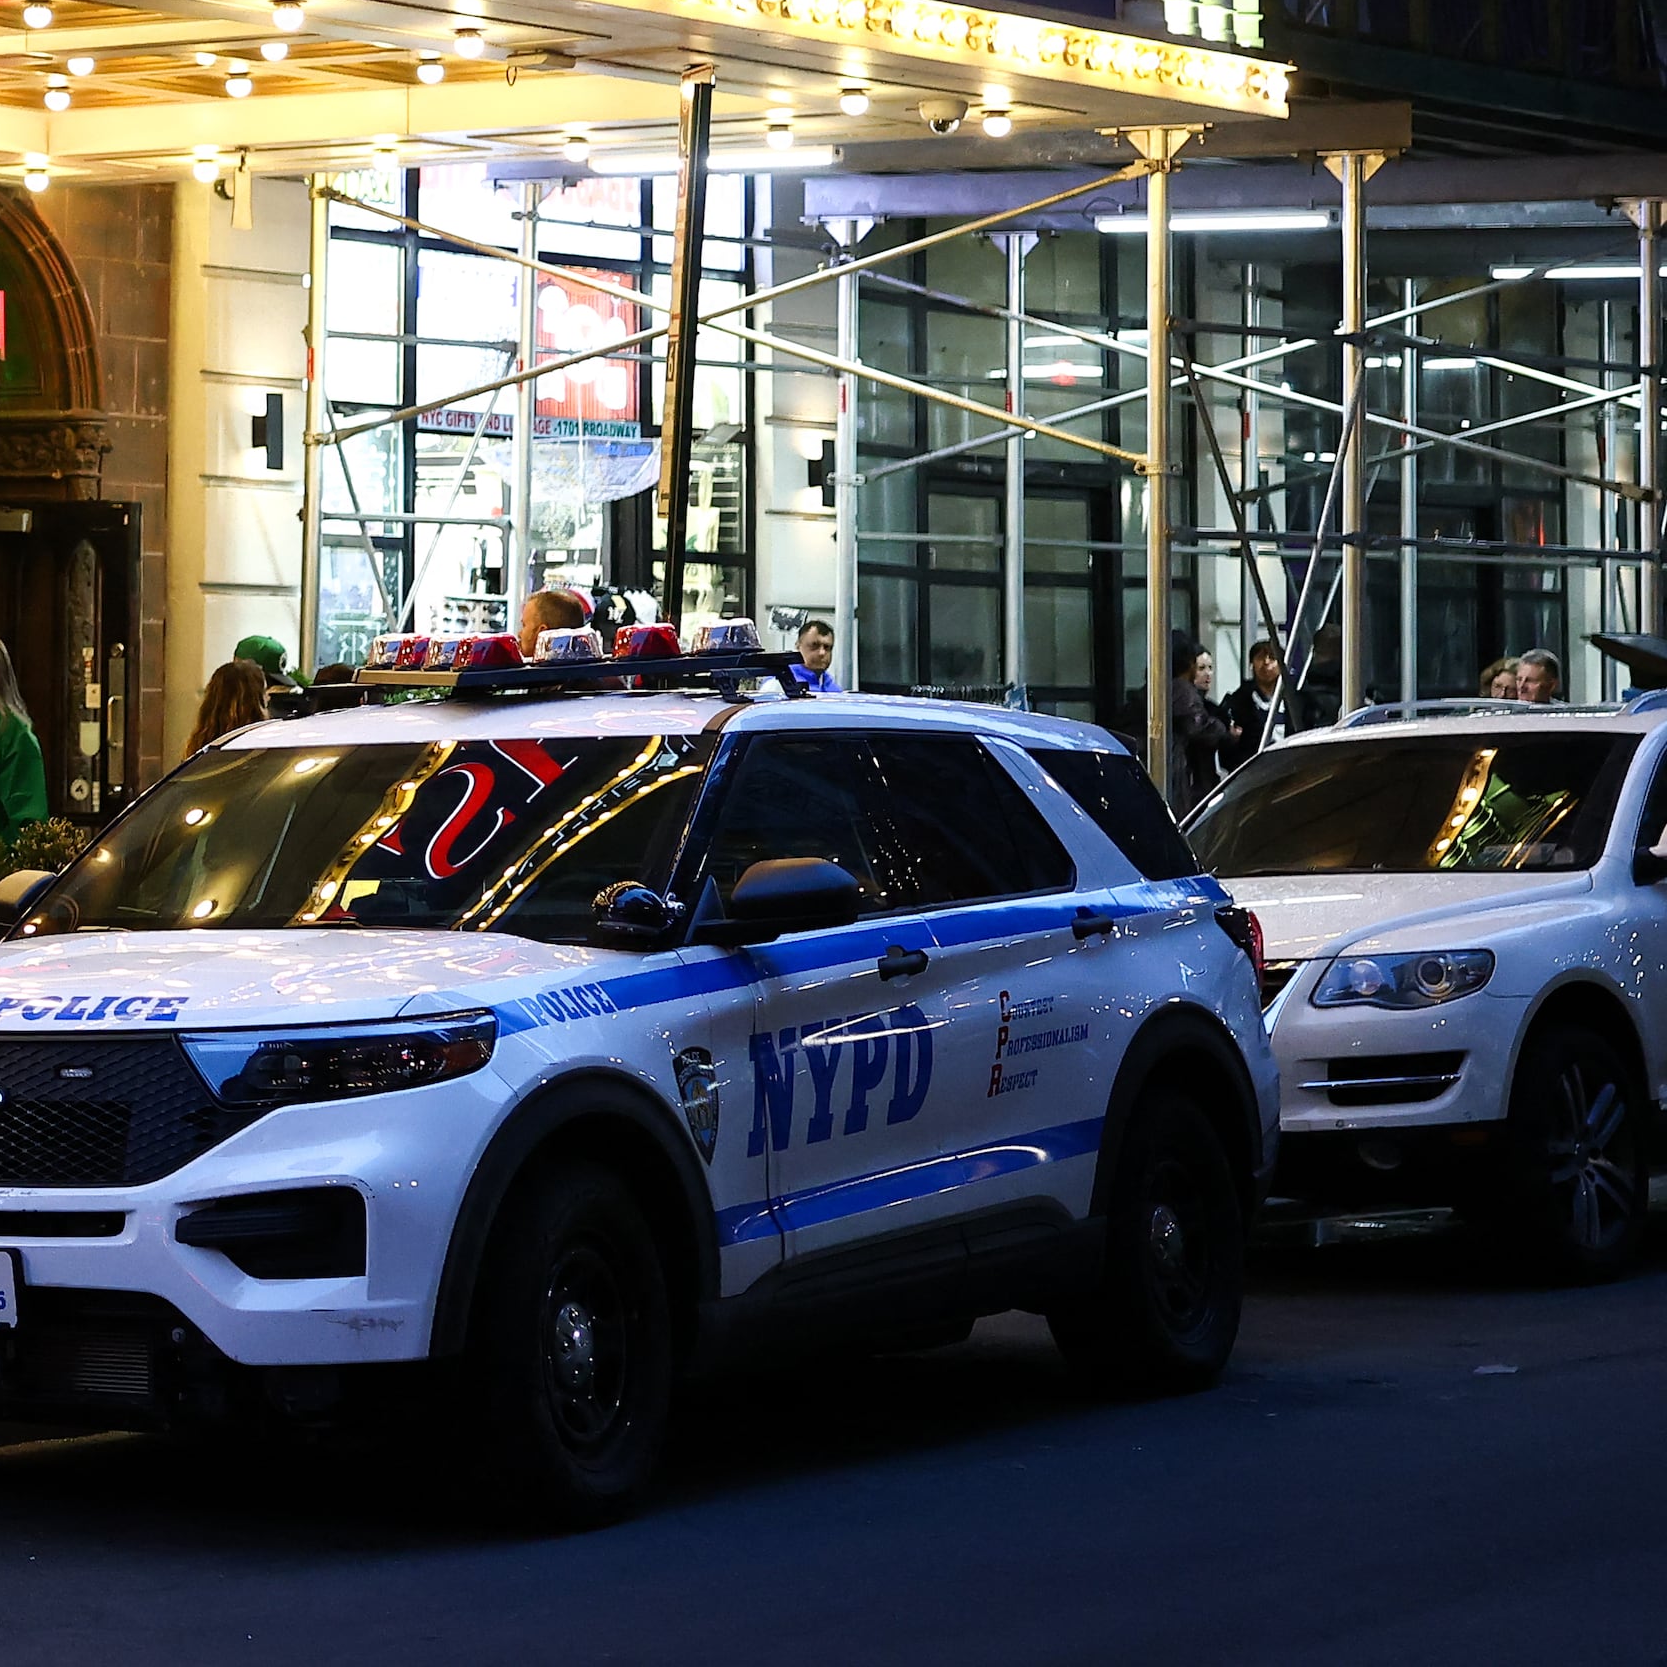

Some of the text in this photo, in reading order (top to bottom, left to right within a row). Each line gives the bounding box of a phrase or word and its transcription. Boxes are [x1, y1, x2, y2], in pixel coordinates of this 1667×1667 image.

[446, 412, 476, 429] GIFTS
[519, 982, 614, 1027] POLICE
[995, 1022, 1089, 1061] PROFESSIONALISM
[747, 1005, 933, 1158] NYPD
[987, 1063, 1038, 1098] RESPECT
